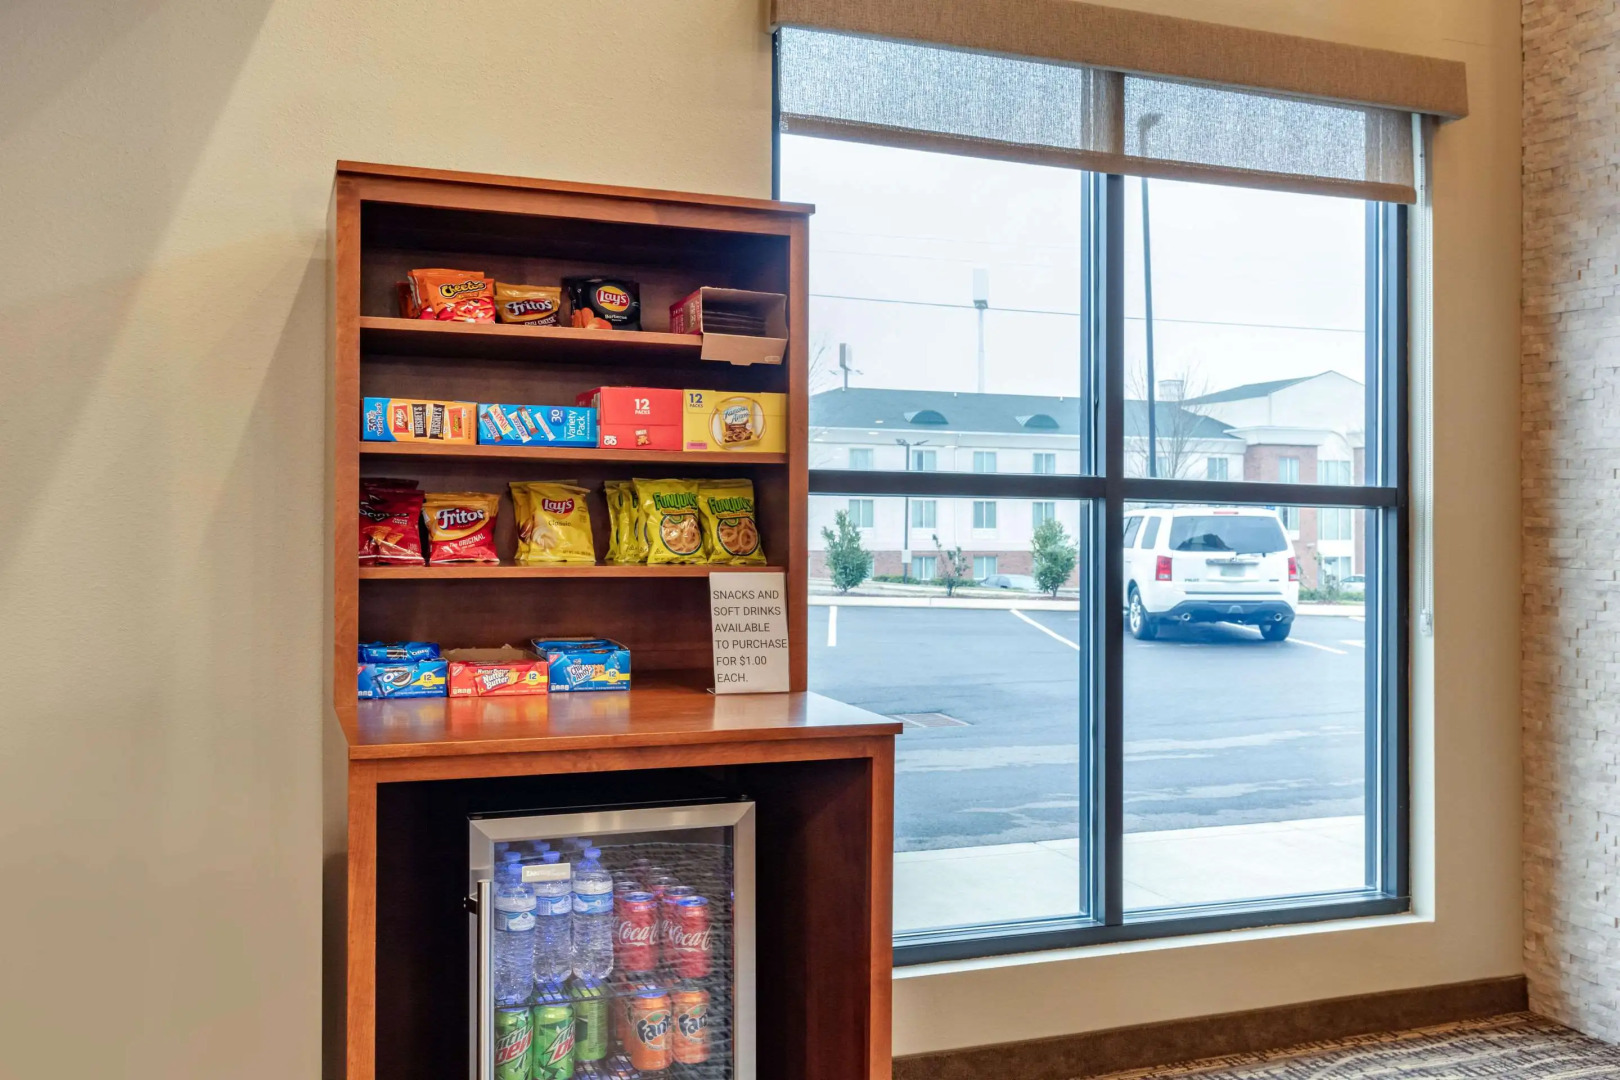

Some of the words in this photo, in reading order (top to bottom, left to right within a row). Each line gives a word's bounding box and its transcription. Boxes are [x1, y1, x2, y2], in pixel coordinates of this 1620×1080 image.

[440, 281, 486, 298] Cheetos
[600, 290, 627, 306] Lay's
[505, 300, 553, 316] Fritos
[634, 398, 650, 410] 12
[689, 393, 703, 404] 12
[551, 409, 562, 423] 30
[567, 410, 578, 439] Variety
[576, 415, 586, 436] Pack
[544, 499, 573, 514] Lay's
[653, 492, 698, 511] FUNYUNS
[707, 497, 754, 515] FUNYUNS
[435, 508, 484, 530] Fritos
[458, 533, 485, 546] ORIGINAL
[713, 590, 755, 600] SNACKS
[757, 590, 780, 600] AND
[713, 606, 741, 616] SOFT
[743, 606, 781, 616] DRINKS
[714, 622, 771, 633] AVAILABLE
[715, 640, 730, 650] TO
[732, 639, 788, 649] PURCHASE
[716, 656, 737, 666] FOR
[739, 655, 767, 667] $1.00
[482, 671, 506, 684] Nutter
[485, 676, 509, 690] Butter
[717, 673, 749, 683] EACH.
[637, 1014, 671, 1044] Fant
[679, 1010, 709, 1038] Fan
